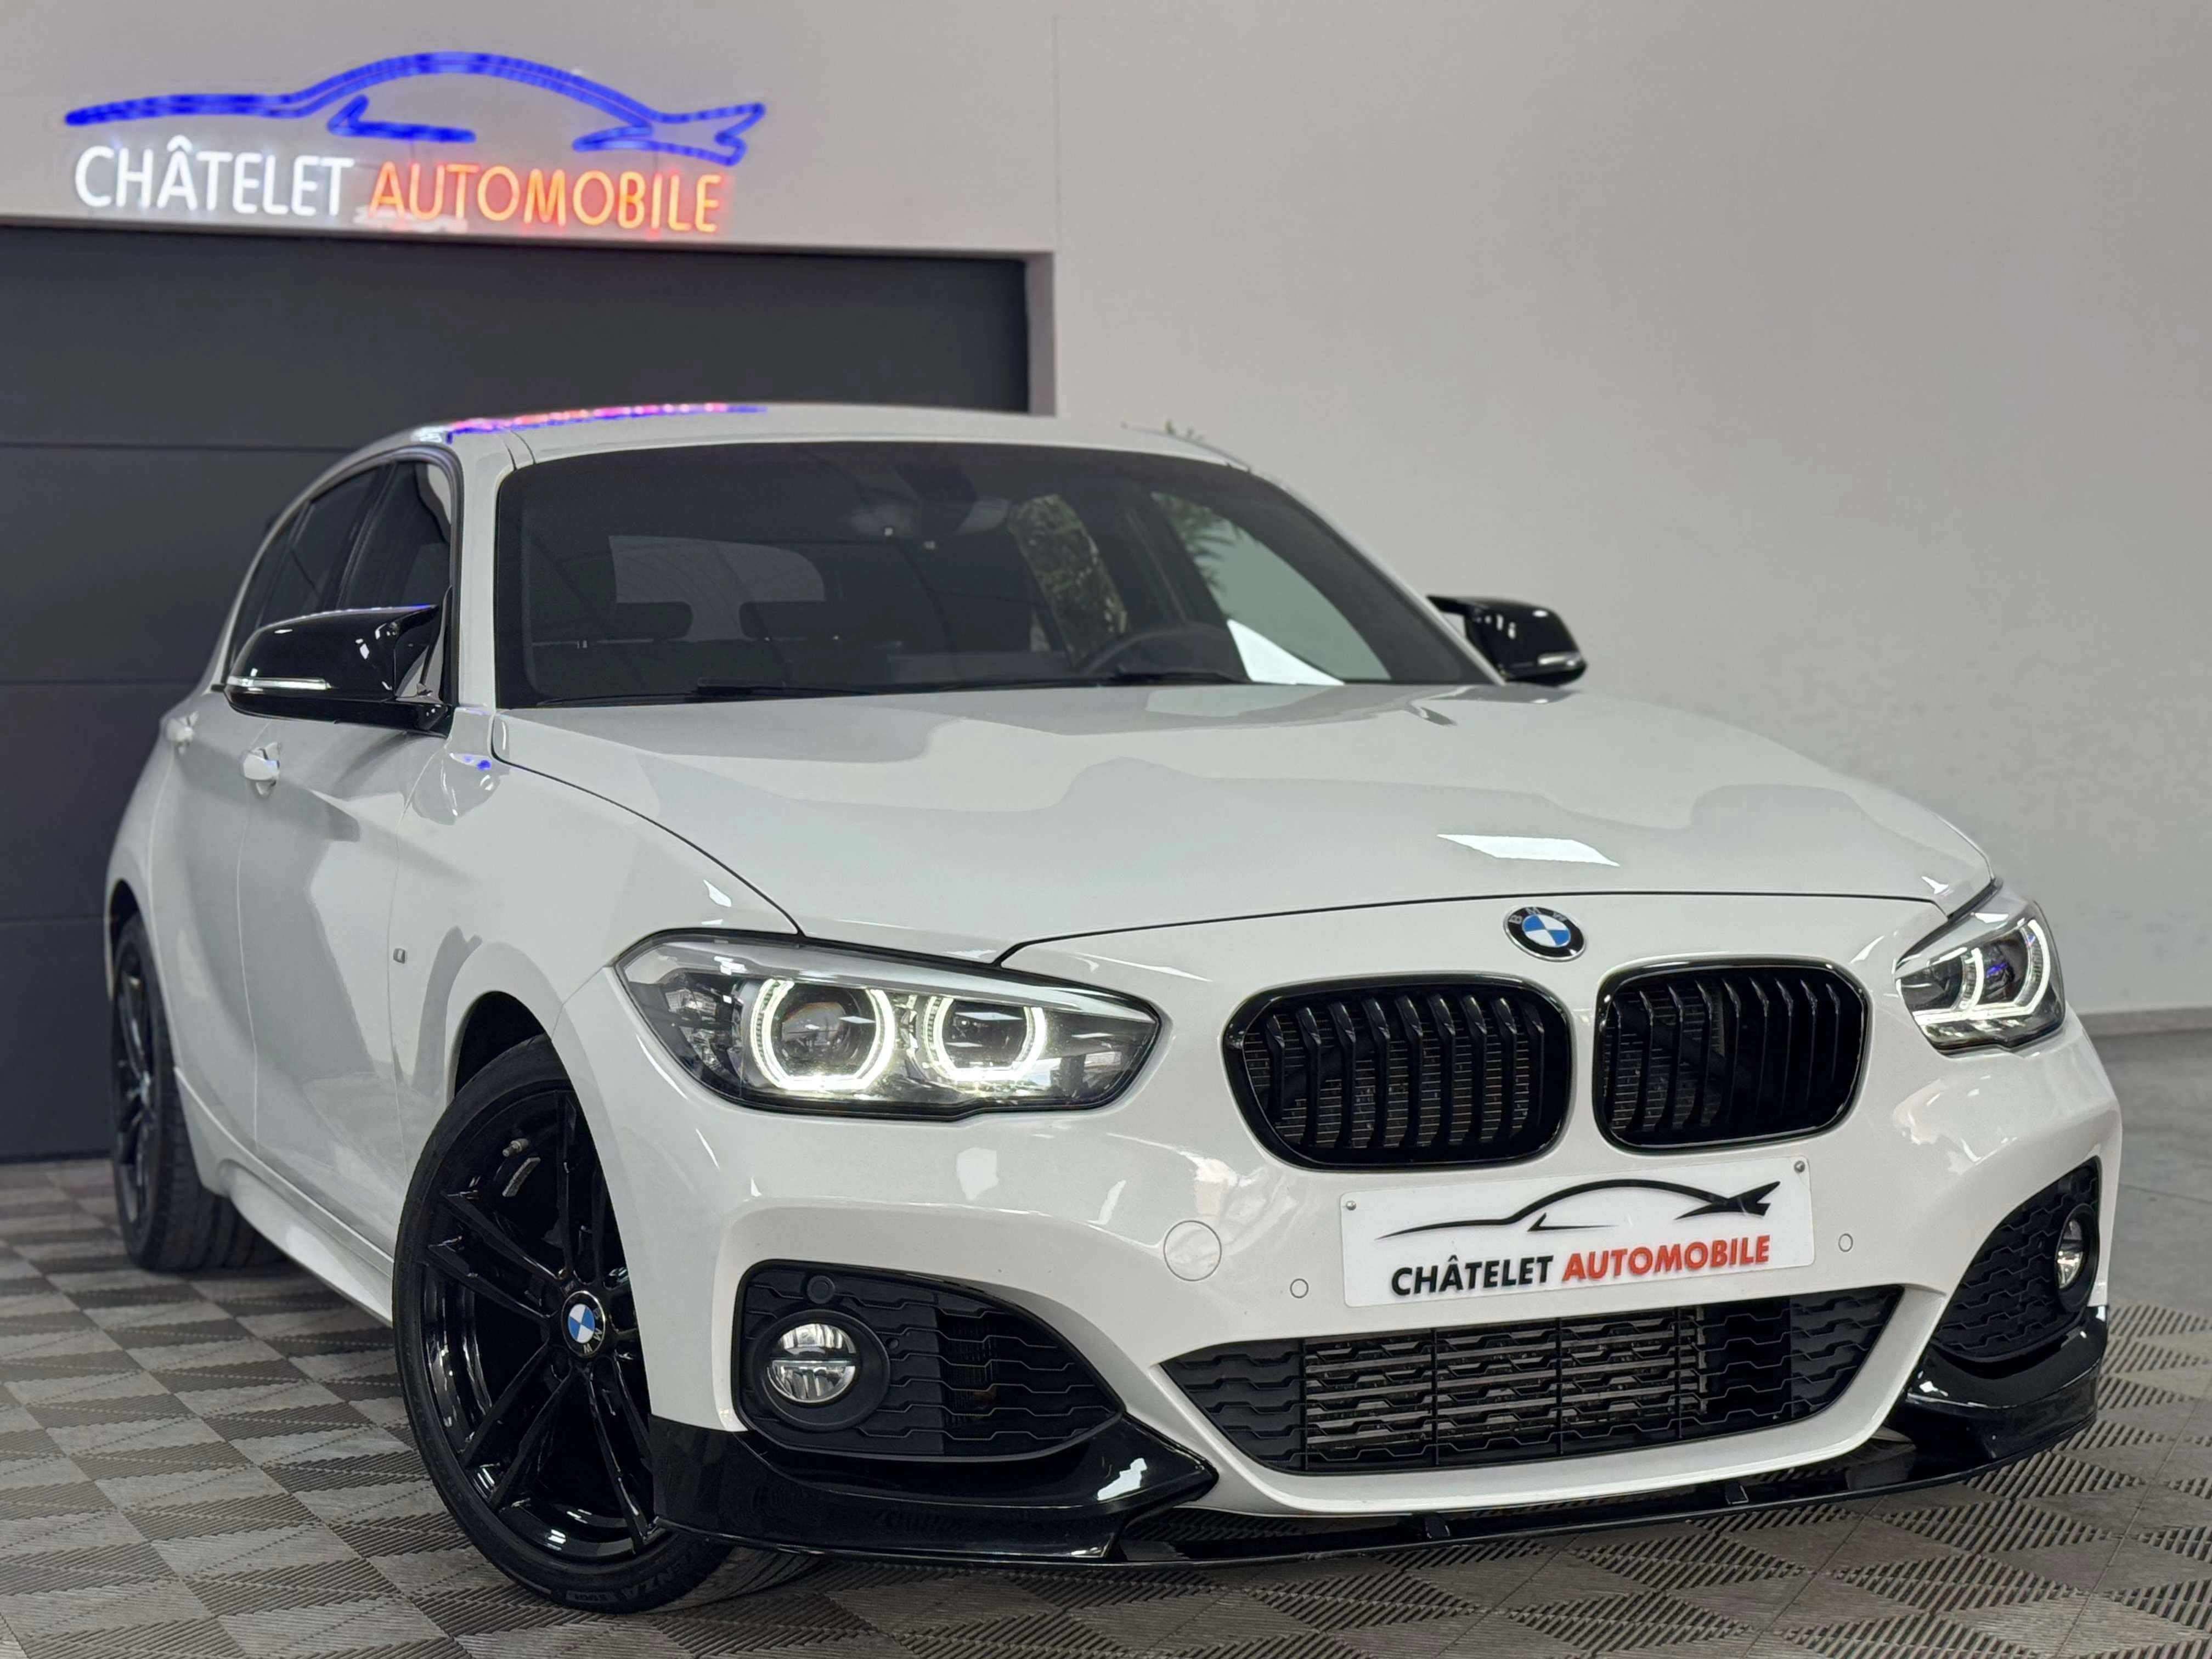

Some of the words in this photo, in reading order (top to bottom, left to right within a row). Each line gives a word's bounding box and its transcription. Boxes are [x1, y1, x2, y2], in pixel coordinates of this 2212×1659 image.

[75, 134, 355, 217] CHÂTELET
[368, 161, 721, 233] AUTOMOBILE
[1509, 907, 1568, 924] BMW
[1391, 1255, 1554, 1296] CHÂTELET
[1561, 1234, 1771, 1282] AUTOMOBILE
[583, 1307, 603, 1355] BMW
